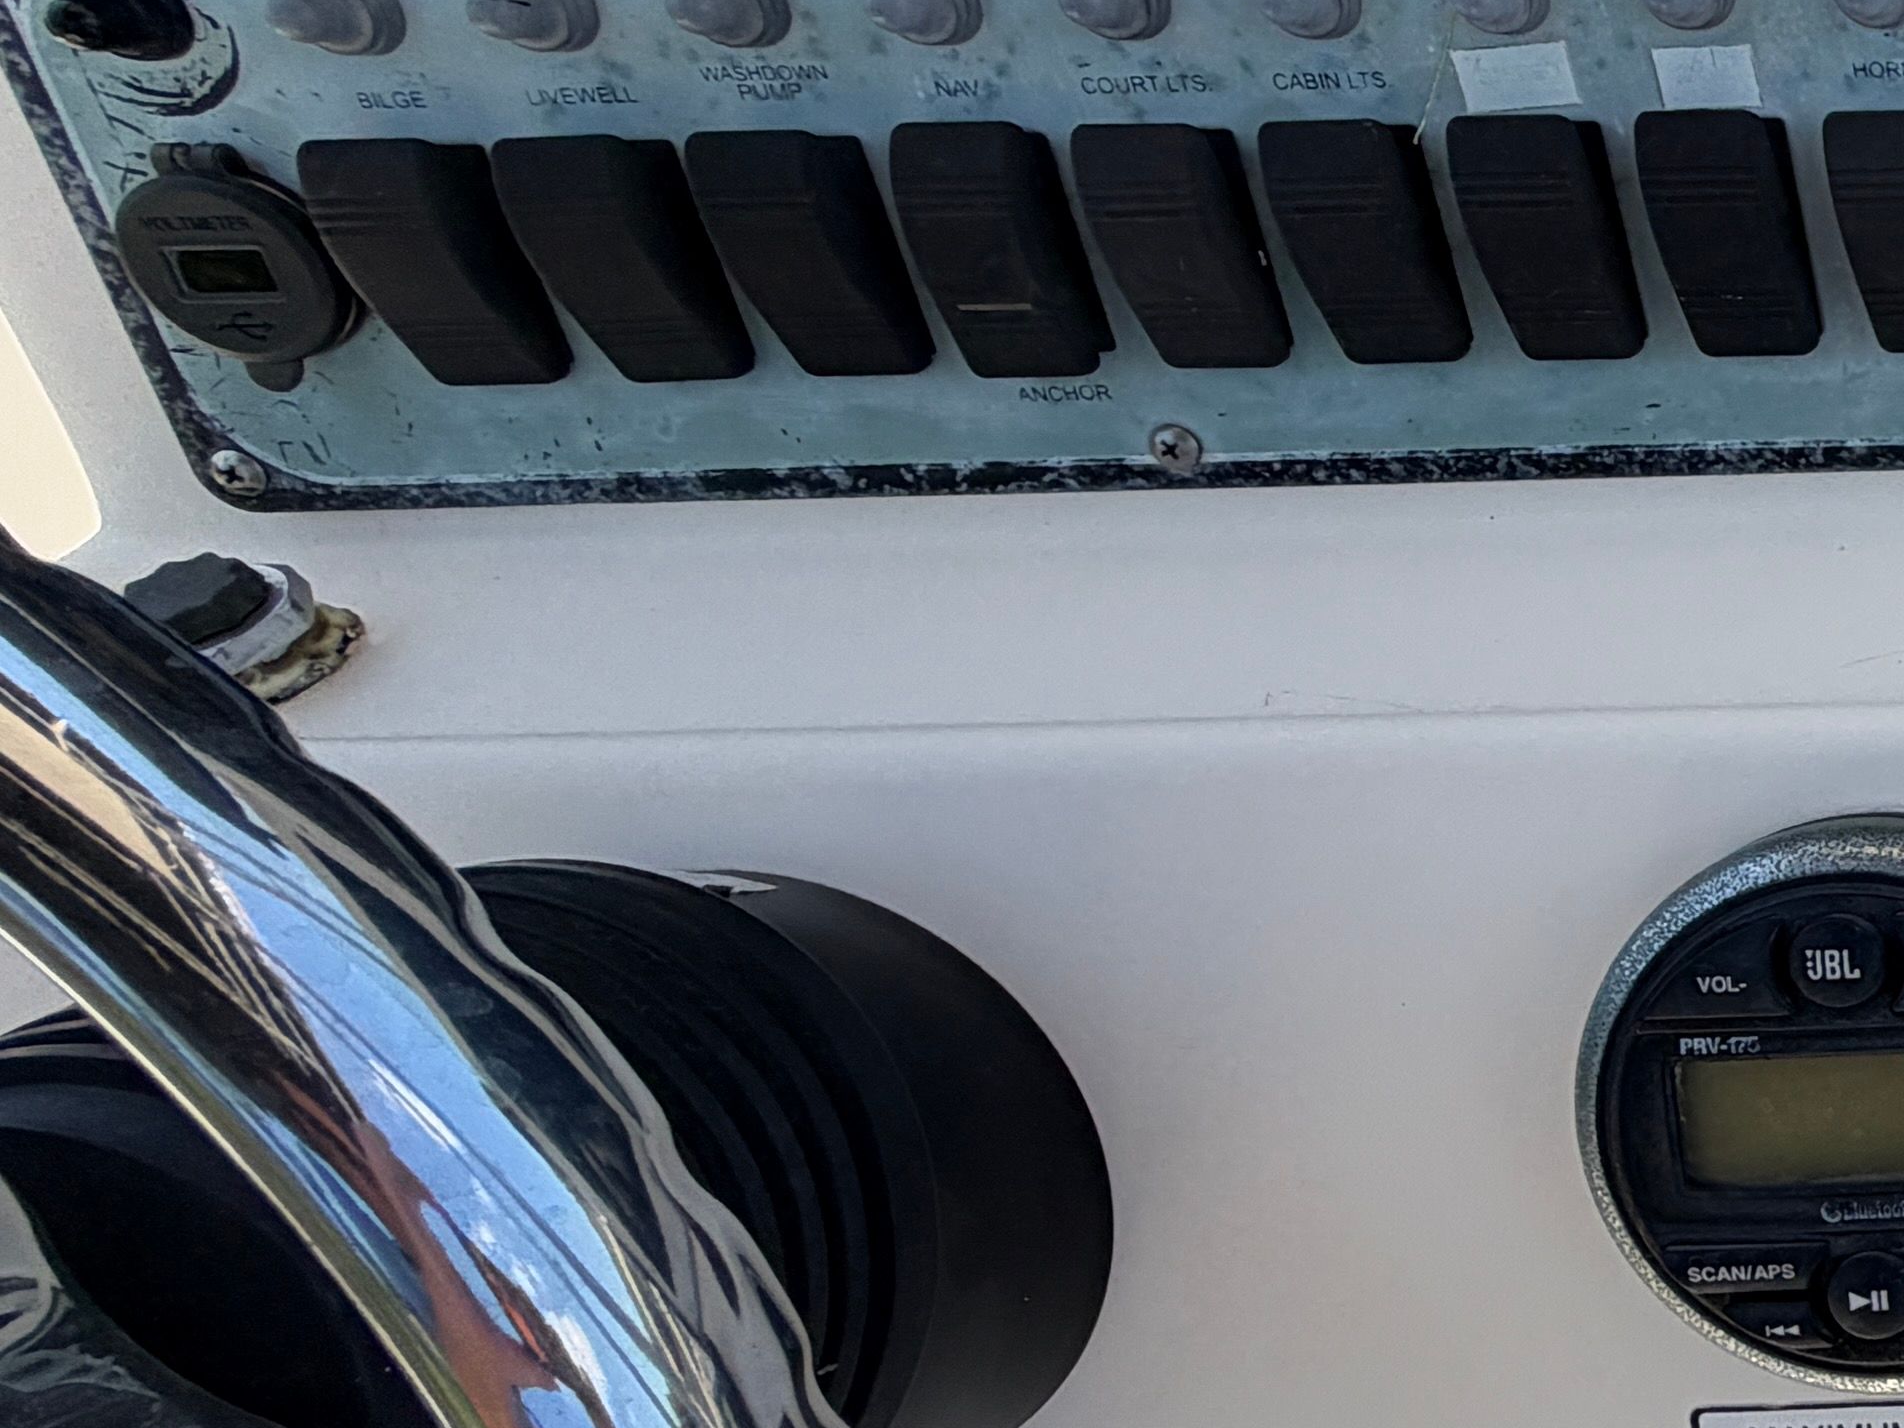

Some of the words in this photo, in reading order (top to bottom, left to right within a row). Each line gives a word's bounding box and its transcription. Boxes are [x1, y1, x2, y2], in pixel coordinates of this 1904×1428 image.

[700, 64, 829, 83] WASHDOWN
[1273, 71, 1341, 91] CABIN
[738, 83, 802, 101] PUMP
[934, 80, 978, 97] NAV
[1081, 75, 1158, 96] COURT
[1166, 73, 1213, 94] LTS.
[358, 92, 426, 110] BILGE
[526, 87, 638, 107] LIVEWELL
[1018, 384, 1112, 404] ANCHOR
[1805, 949, 1861, 980] JBL
[1696, 976, 1748, 993] VOL-
[1679, 1036, 1761, 1056] PRV-175
[1687, 1264, 1796, 1283] SCAN/APS
